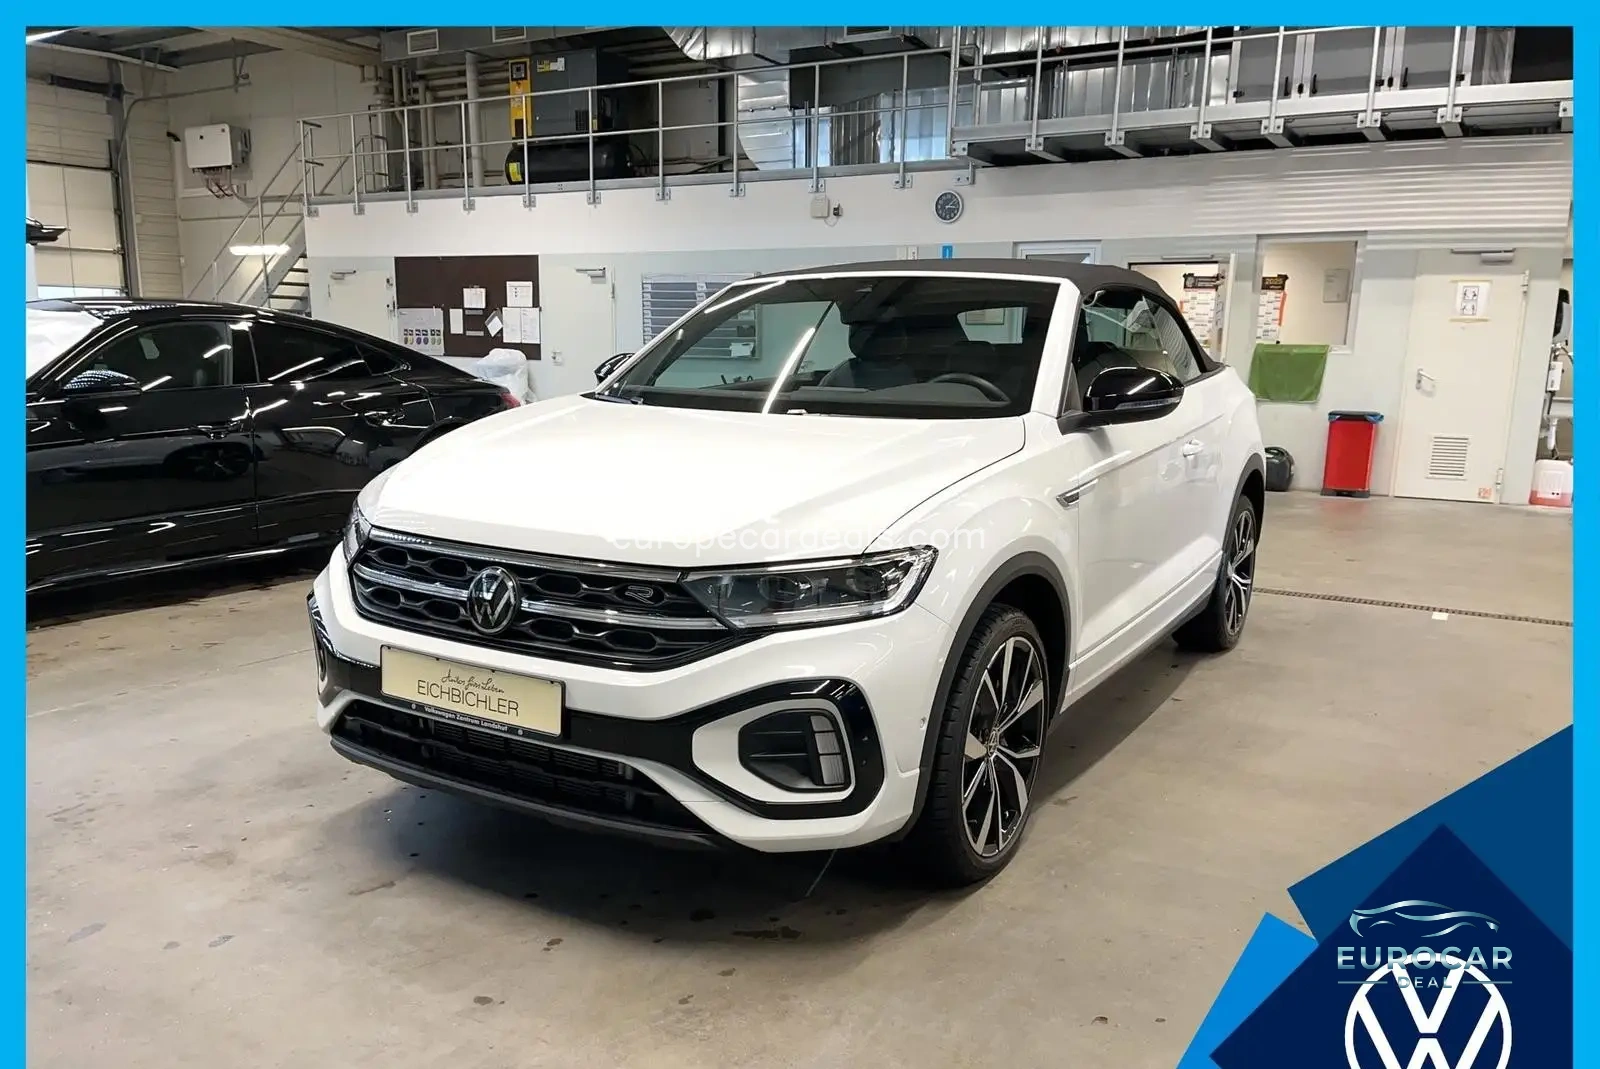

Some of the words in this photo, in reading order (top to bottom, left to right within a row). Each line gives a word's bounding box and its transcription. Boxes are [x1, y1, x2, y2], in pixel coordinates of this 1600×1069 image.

[417, 680, 519, 717] EICHBICHLER
[424, 706, 456, 719] Volkswagen
[456, 713, 480, 725] Zentrum
[480, 720, 508, 732] Landshut
